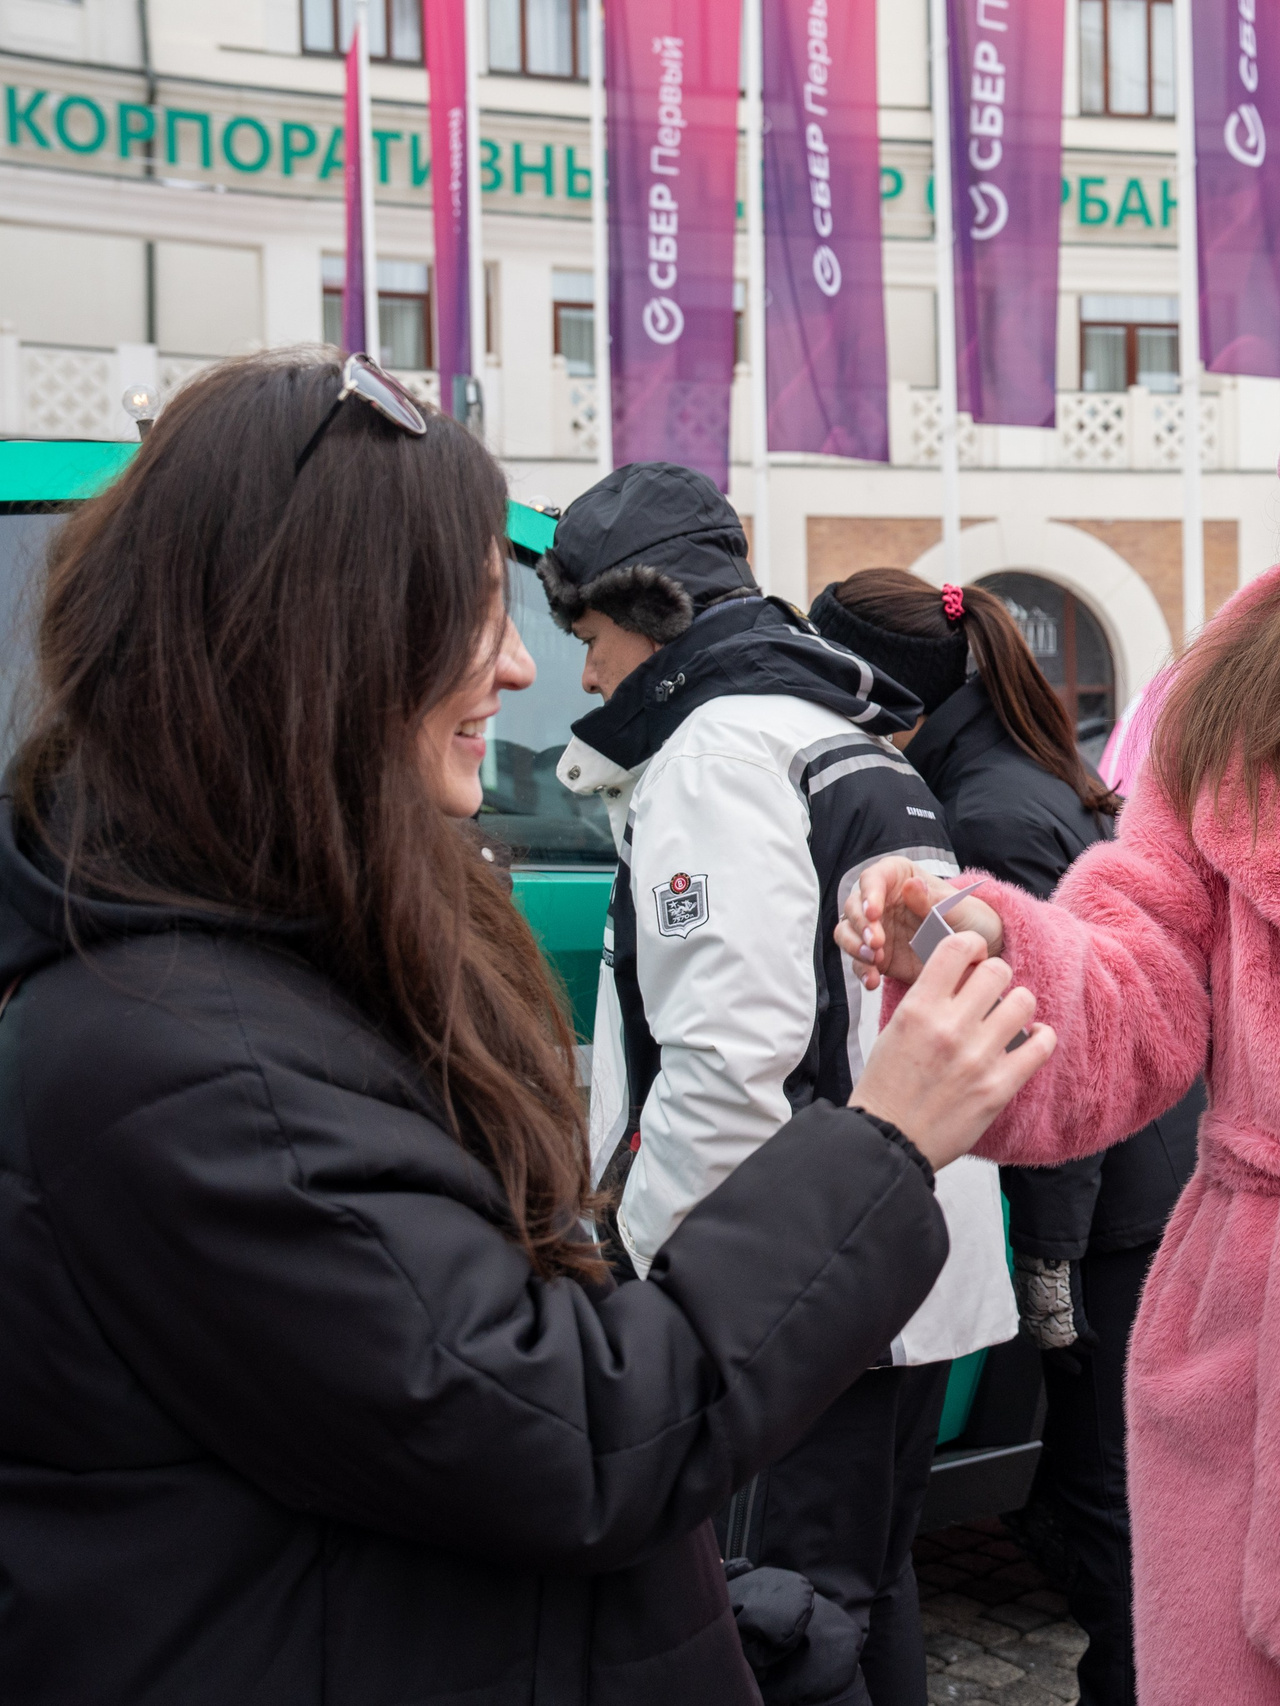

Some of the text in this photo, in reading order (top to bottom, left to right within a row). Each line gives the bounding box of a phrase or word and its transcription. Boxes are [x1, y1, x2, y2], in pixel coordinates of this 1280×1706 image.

[803, 0, 834, 237] СБЕР Первы
[969, 40, 1006, 171] СБЕР
[1238, 0, 1258, 93] СБЕ
[649, 36, 687, 290] СБЕР Первый
